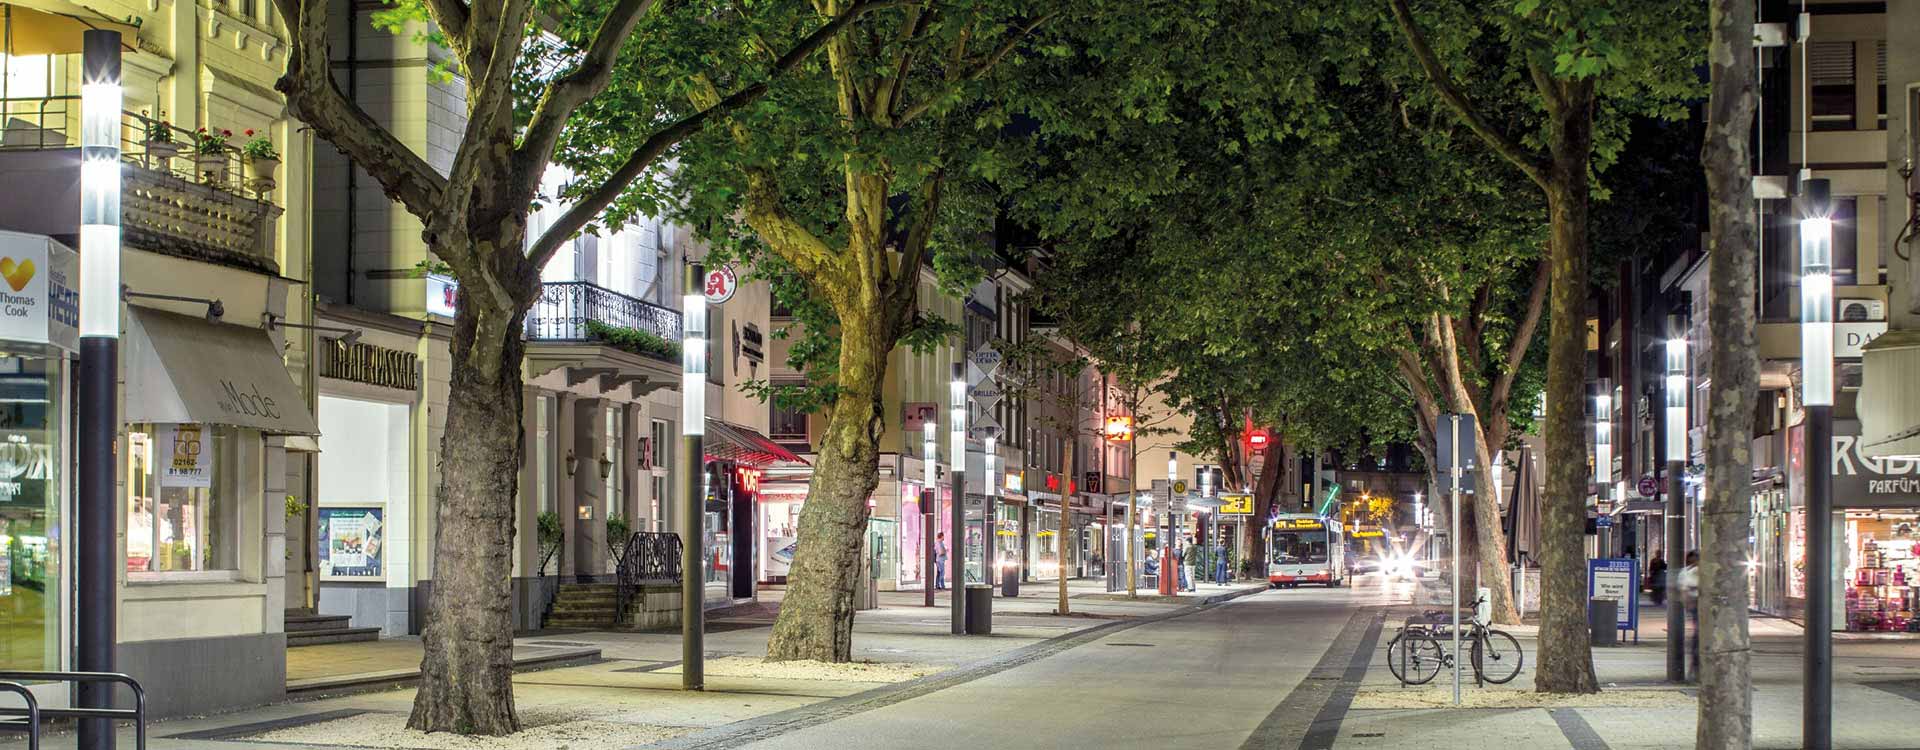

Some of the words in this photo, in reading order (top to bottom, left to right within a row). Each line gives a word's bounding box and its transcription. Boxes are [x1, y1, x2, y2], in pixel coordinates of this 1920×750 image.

[0, 291, 35, 306] Thomas
[5, 304, 28, 318] Cook
[220, 379, 281, 419] Mode
[1869, 477, 1920, 494] PARFÜM
